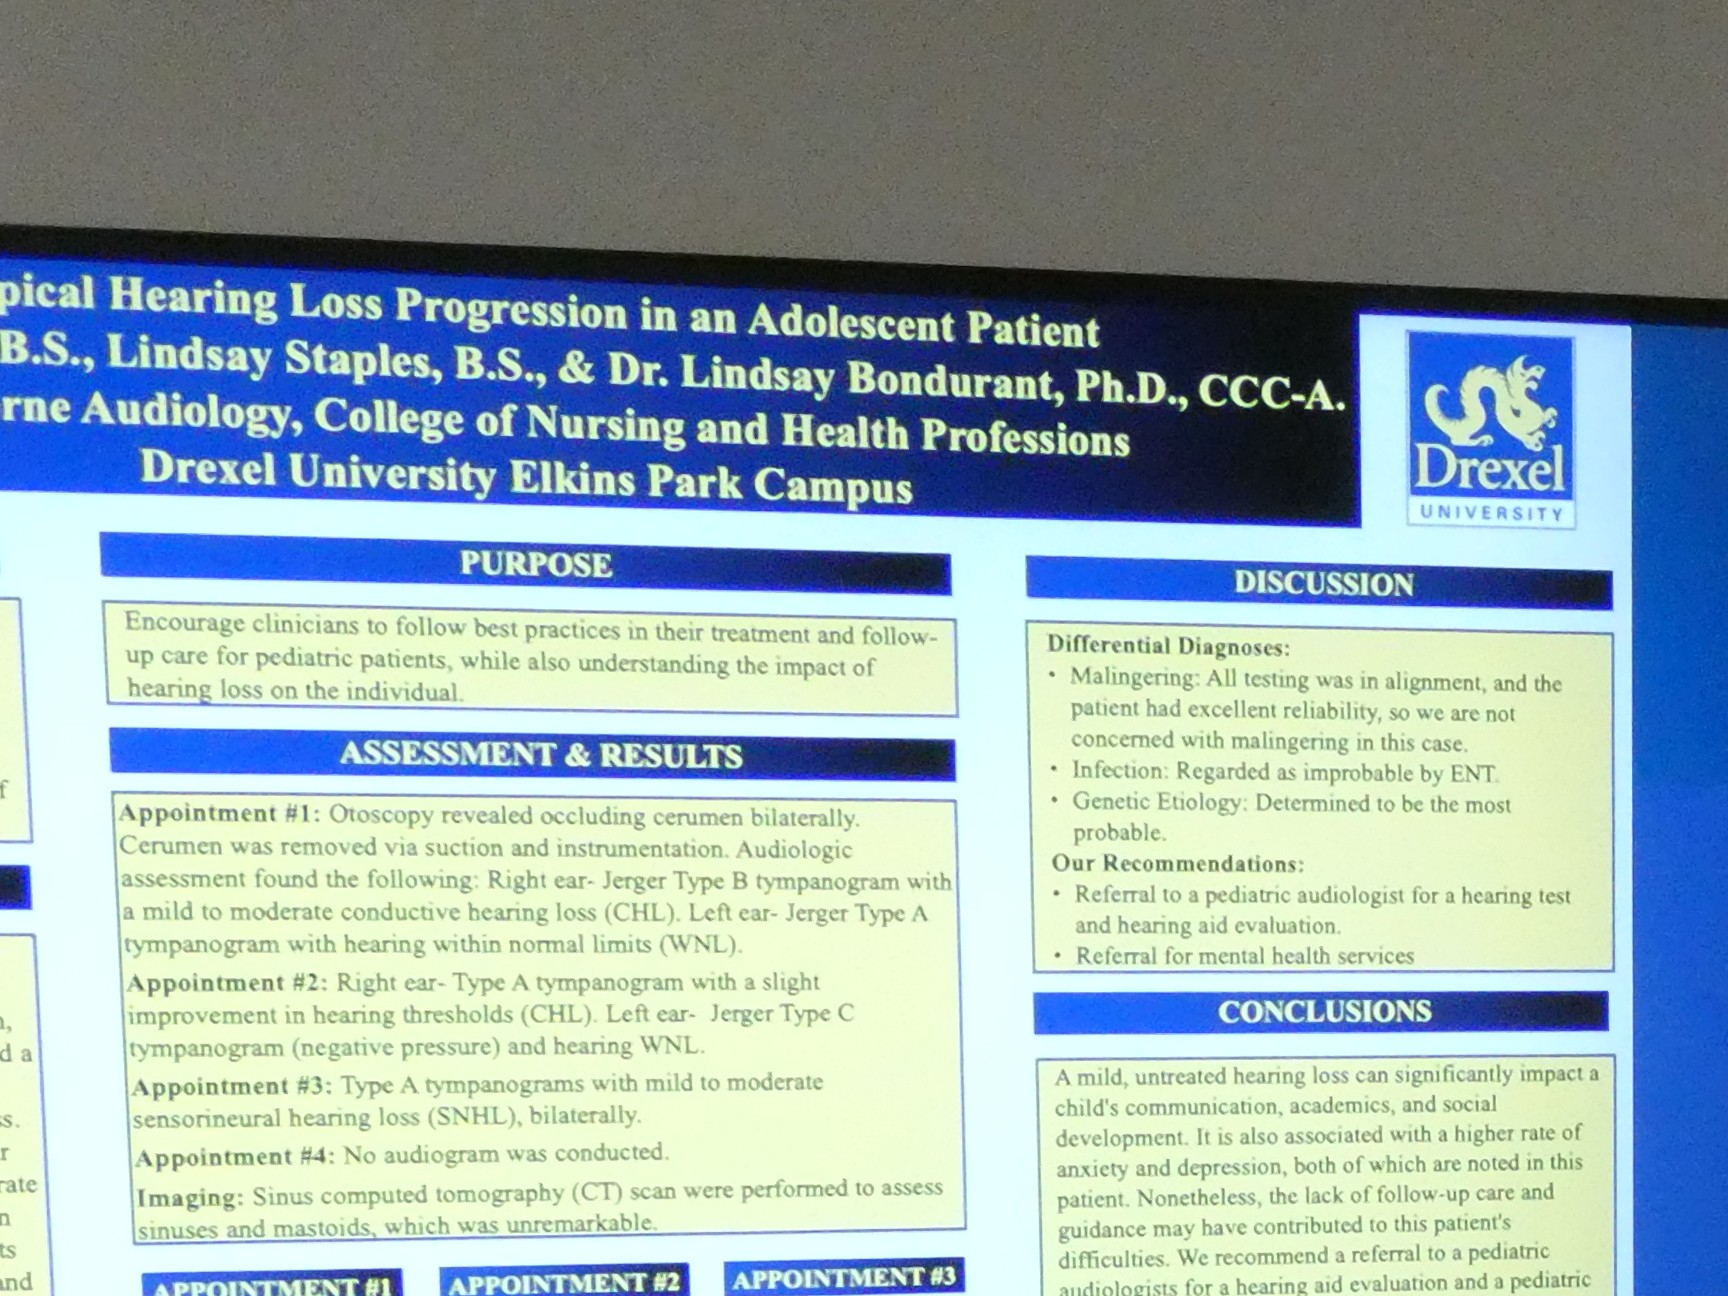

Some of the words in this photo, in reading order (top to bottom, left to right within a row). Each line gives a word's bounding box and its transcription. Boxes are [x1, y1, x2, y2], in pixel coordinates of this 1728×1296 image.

[109, 275, 279, 326] Hearing
[289, 282, 383, 321] Loss
[395, 286, 628, 334] Progression
[640, 295, 678, 333] in
[689, 307, 737, 335] an
[747, 302, 956, 343] Adolescent
[966, 310, 1101, 349] Patient
[0, 329, 95, 374] B.S.,
[107, 332, 273, 382] Lindsay
[285, 339, 443, 386] Staples,
[453, 345, 547, 390] B.S.,
[558, 349, 596, 385] &
[608, 350, 669, 387] Dr.
[680, 353, 836, 402] Lindsay
[846, 359, 1065, 408] Bondurant,
[1075, 368, 1189, 413] Ph.D.,
[1198, 373, 1346, 412] CCC-A.
[2, 396, 71, 423] rne
[80, 390, 304, 440] Audiology,
[314, 396, 464, 445] College
[475, 402, 519, 437] of
[525, 404, 687, 452] Nursing
[696, 412, 770, 446] and
[780, 412, 910, 451] Health
[920, 417, 1131, 458] Professions
[140, 448, 277, 486] Drexel
[288, 452, 497, 501] University
[509, 459, 636, 497] Elkins
[646, 462, 744, 500] Park
[754, 465, 914, 513] Campus
[1415, 442, 1565, 493] Drexel
[1420, 503, 1563, 523] UNIVERSITY
[460, 549, 614, 579] PURPOSE
[1235, 569, 1415, 597] DISCUSSION
[124, 609, 246, 638] Encourage
[252, 612, 360, 635] clinicians
[367, 619, 388, 636] to
[396, 614, 467, 637] follow
[473, 616, 519, 639] best
[524, 618, 621, 644] practices
[627, 620, 649, 641] in
[655, 620, 705, 642] their
[710, 625, 810, 645] treatment
[817, 624, 855, 646] and
[862, 624, 938, 647] follow-
[1048, 633, 1171, 655] Differential
[1178, 636, 1290, 661] Diagnoses:
[125, 649, 154, 670] up
[161, 649, 208, 666] care
[216, 644, 250, 666] for
[255, 645, 353, 672] pediatric
[360, 648, 454, 674] patients,
[460, 649, 521, 671] while
[527, 650, 571, 672] also
[578, 653, 731, 680] understanding
[736, 654, 769, 675] the
[776, 655, 847, 682] impact
[852, 656, 878, 678] of
[127, 676, 213, 704] hearing
[220, 678, 263, 700] loss
[270, 685, 299, 701] on
[305, 679, 340, 701] the
[346, 680, 464, 703] individual.
[1070, 665, 1200, 692] Malingering:
[1205, 667, 1237, 688] All
[1244, 672, 1310, 694] testing
[1315, 674, 1354, 690] was
[1360, 676, 1379, 690] in
[1385, 670, 1487, 696] alignment,
[1493, 673, 1528, 694] and
[1534, 673, 1563, 693] the
[1070, 701, 1140, 722] patient
[1145, 697, 1182, 718] had
[1187, 699, 1277, 719] excellent
[1283, 700, 1382, 726] reliability,
[1388, 707, 1411, 721] so
[1416, 707, 1445, 722] we
[1450, 708, 1481, 722] are
[1485, 707, 1516, 724] not
[339, 739, 558, 768] ASSESSMENT
[564, 742, 592, 768] &
[599, 742, 744, 770] RESULTS
[1073, 759, 1169, 780] Infection:
[1177, 760, 1271, 786] Regarded
[1277, 767, 1297, 782] as
[1303, 762, 1414, 787] improbable
[1419, 763, 1444, 788] by
[118, 801, 278, 831] Appointment
[285, 803, 320, 823] #1:
[329, 802, 434, 830] Otoscopy
[441, 804, 533, 825] revealed
[540, 805, 647, 831] occluding
[653, 812, 744, 827] cerumen
[750, 807, 860, 832] bilaterally.
[1051, 853, 1096, 873] Our
[1103, 853, 1304, 873] Recommendations:
[1218, 998, 1433, 1025] CONCLUSIONS
[21, 1047, 33, 1063] a
[1054, 1068, 1071, 1087] A
[1077, 1066, 1129, 1089] mild,
[1135, 1065, 1227, 1086] untreated
[1233, 1065, 1306, 1090] hearing
[1312, 1065, 1350, 1085] loss
[1355, 1069, 1389, 1084] can
[1394, 1063, 1514, 1089] significantly
[1519, 1067, 1584, 1088] impact
[1589, 1067, 1600, 1081] a
[134, 1145, 292, 1174] Appointment
[300, 1146, 335, 1165] #4:
[343, 1145, 376, 1165] No
[384, 1144, 500, 1170] audiogram
[506, 1148, 548, 1163] was
[554, 1141, 669, 1162] conducted.
[448, 1271, 649, 1296] APPOINTMENT
[652, 1271, 681, 1293] #2
[732, 1266, 926, 1291] APPOINTMENT
[929, 1265, 957, 1286] #3
